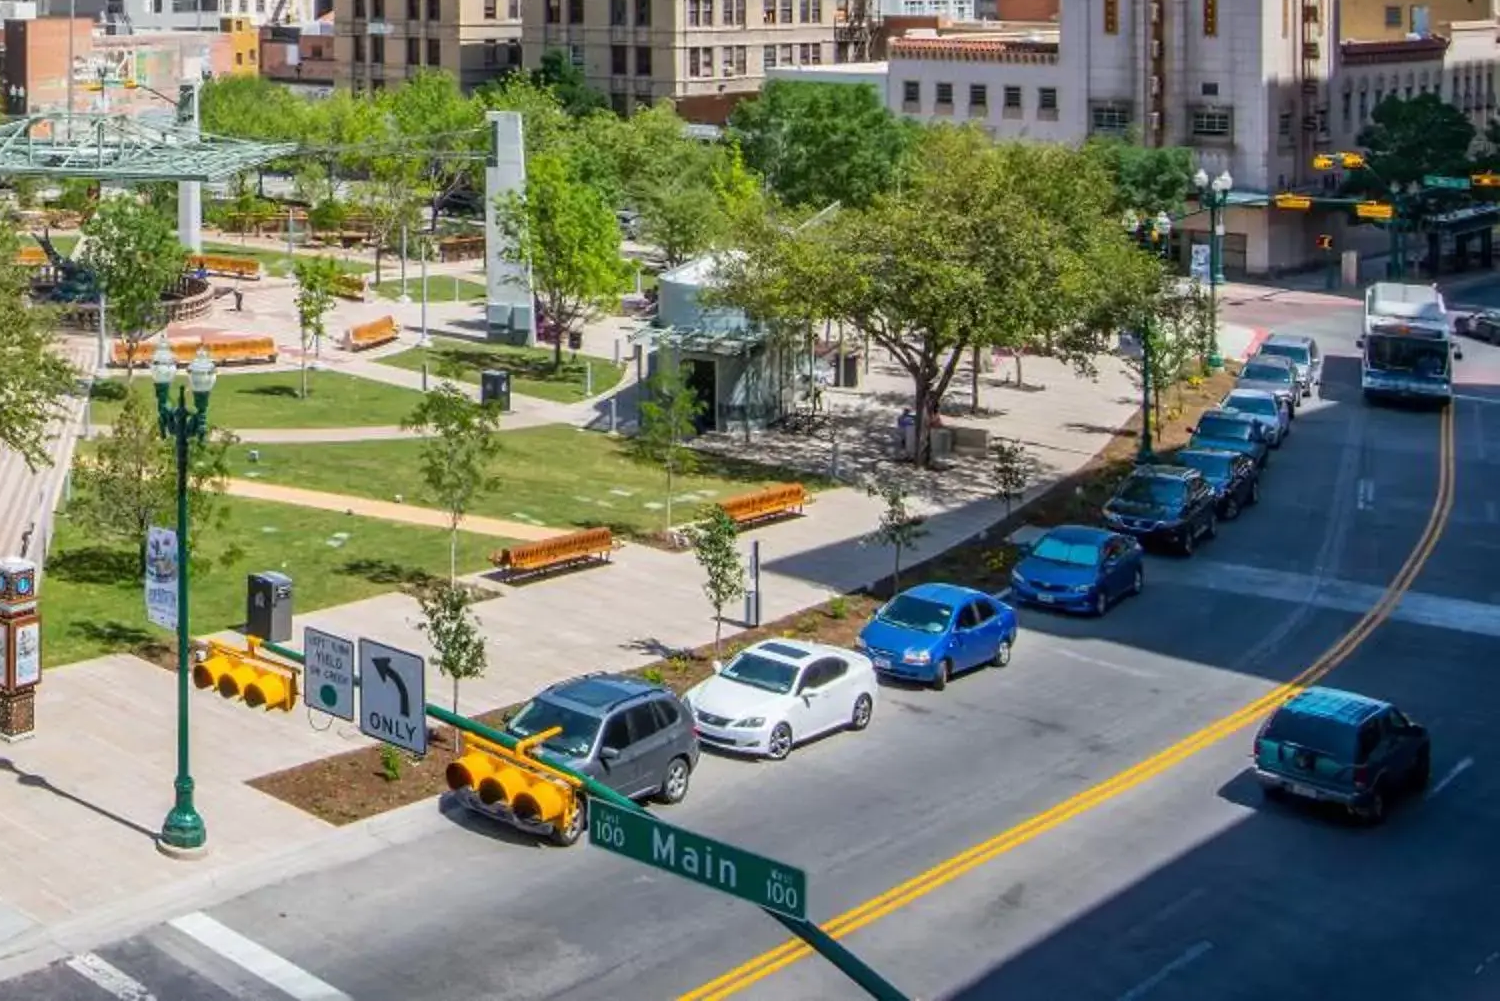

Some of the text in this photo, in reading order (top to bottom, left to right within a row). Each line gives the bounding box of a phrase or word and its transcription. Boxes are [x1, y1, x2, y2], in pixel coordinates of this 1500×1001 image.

[369, 712, 417, 742] ONLY
[596, 819, 798, 909] 100 Main 100
